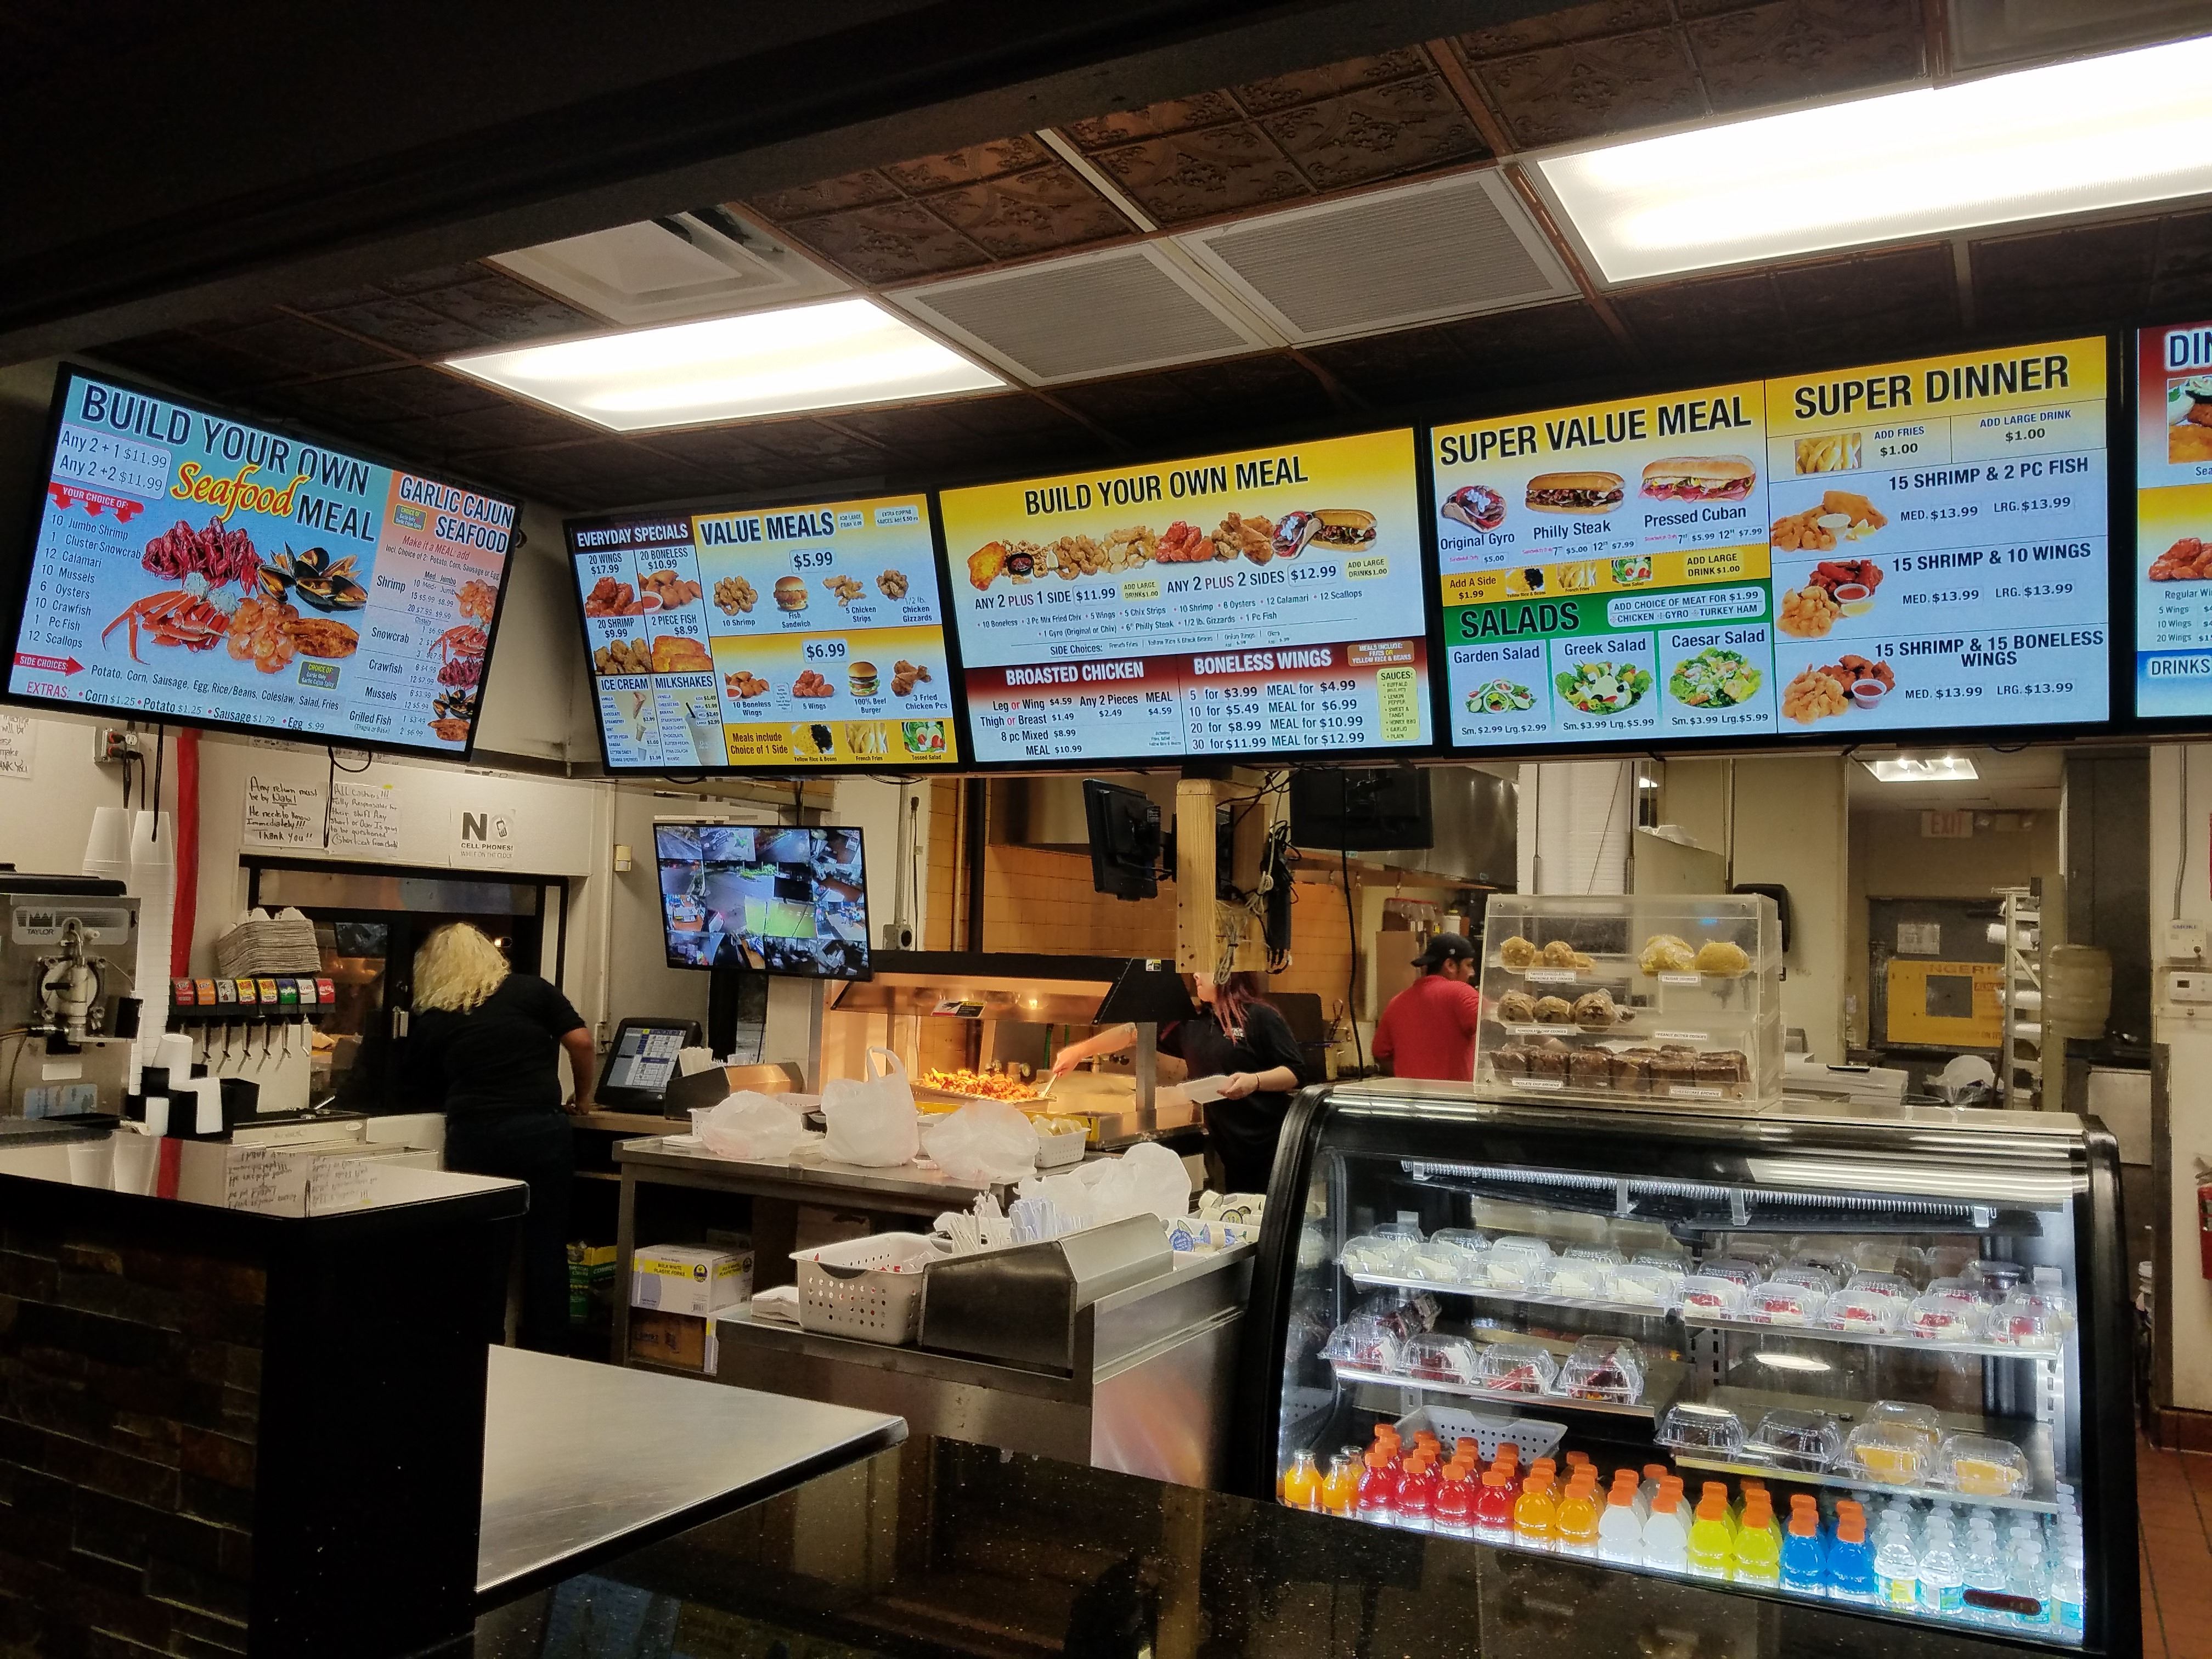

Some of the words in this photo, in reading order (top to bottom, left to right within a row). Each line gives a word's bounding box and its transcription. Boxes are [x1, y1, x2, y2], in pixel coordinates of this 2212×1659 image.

[1795, 374, 1912, 419] SUPER
[1926, 355, 2068, 403] DINNER
[1980, 417, 2001, 428] ADD
[2004, 413, 2037, 425] LARGE
[2040, 409, 2071, 422] DRINK
[81, 385, 191, 445] BUILD
[204, 418, 290, 474] YOUR
[298, 449, 370, 495] OWN
[1441, 425, 1537, 466] SUPER
[1546, 409, 1646, 451] VALUE
[1658, 396, 1751, 437] MEAL
[2005, 428, 2046, 443] $1.00
[62, 431, 86, 452] Any
[89, 438, 98, 453] 2
[115, 444, 119, 458] 1
[123, 449, 167, 467] $11.99
[1025, 484, 1091, 515] BUILD
[1098, 475, 1162, 506] YOUR
[1170, 465, 1227, 498] OWN
[1236, 455, 1308, 490] MEAL
[63, 487, 85, 499] YOUR
[86, 492, 115, 506] CHOICE
[116, 500, 128, 509] OF:
[171, 462, 311, 523] Seafood
[297, 494, 375, 542] MEAL
[400, 477, 461, 513] GARLIC
[464, 496, 514, 528] CAJUN
[1645, 510, 1698, 528] Pressed
[1702, 507, 1746, 521] Cuban
[52, 515, 63, 526] 10
[69, 518, 95, 533] Jumbo
[98, 525, 128, 541] Shrimp
[436, 516, 507, 553] SEAFOOD
[577, 531, 631, 547] EVERYDAY
[634, 523, 688, 542] SPECIALS
[701, 519, 761, 545] VALUE
[766, 512, 834, 541] MEALS
[1534, 526, 1568, 540] Philly
[1573, 520, 1611, 535] Steak
[45, 549, 56, 558] 12
[63, 551, 102, 568] Calamari
[589, 555, 597, 564] 20
[599, 553, 622, 563] WINGS
[640, 551, 648, 560] 20
[651, 548, 688, 558] BONELESS
[794, 552, 832, 570] $5.99
[1893, 557, 1912, 572] 15
[1917, 552, 1983, 570] SHRIMP
[1989, 550, 2002, 565] &
[2007, 549, 2028, 562] 10
[2032, 543, 2091, 562] WINGS
[42, 565, 53, 575] 10
[59, 567, 95, 583] Mussels
[591, 565, 619, 575] $17.99
[648, 560, 677, 571] $10.99
[377, 575, 405, 594] Shrimp
[1167, 580, 1189, 593] ANY
[1193, 577, 1201, 590] 2
[1206, 575, 1234, 590] PLUS
[1238, 572, 1246, 586] 2
[1250, 571, 1284, 586] SIDES
[1291, 566, 1336, 582] $12.99
[41, 581, 46, 591] 6
[56, 584, 90, 599] Oysters
[975, 598, 994, 610] ANY
[998, 595, 1005, 607] 2
[1008, 595, 1034, 606] PLUS
[1037, 592, 1042, 604] 1
[1047, 591, 1070, 603] SIDE
[1076, 588, 1115, 603] $11.99
[1902, 594, 1930, 605] MED.
[1932, 590, 1979, 605] $13.99
[36, 597, 46, 608] 10
[53, 600, 91, 616] Crawfish
[1614, 602, 1631, 611] ADD
[1635, 600, 1666, 609] CHOICE
[1683, 597, 1706, 606] MEAT
[1709, 595, 1726, 603] FOR
[1729, 591, 1758, 602] $1.99
[853, 615, 871, 623] Strips
[1461, 602, 1579, 638] SALADS
[29, 631, 39, 641] 12
[46, 634, 82, 648] Scallops
[372, 627, 409, 644] Snowcrab
[1672, 635, 1720, 648] Caesar
[1725, 629, 1765, 644] Salad
[2013, 630, 2104, 650] BONELESS
[806, 644, 845, 661] $6.99
[1454, 650, 1499, 663] Garden
[1503, 646, 1539, 660] Salad
[20, 656, 36, 665] SIDE
[37, 659, 68, 670] CHOICES:
[369, 659, 403, 674] Crawfish
[1194, 654, 1274, 675] BONELESS
[1277, 650, 1331, 669] WINGS
[2152, 659, 2211, 675] DRINKS
[656, 676, 712, 688] MILKSHAKES
[1006, 669, 1078, 685] BROASTED
[1082, 662, 1144, 680] CHICKEN
[1381, 672, 1413, 680] SAUCES:
[27, 681, 69, 698] EXTRAS:
[92, 665, 122, 679] Potato,
[127, 670, 148, 684] Corn,
[153, 674, 189, 690] Sausage,
[194, 680, 210, 693] Egg,
[212, 682, 257, 699] Rice/Beans,
[262, 690, 295, 705] Coleslaw,
[299, 696, 320, 708] Salad,
[322, 699, 338, 710] Fries
[601, 679, 616, 690] ICE
[618, 678, 648, 690] CREAM
[365, 687, 397, 701] Mussels
[349, 711, 374, 724] Grilled
[375, 715, 391, 726] Fish
[861, 707, 881, 715] Burger
[980, 716, 1005, 727] Thigh
[1007, 717, 1015, 725] or
[1018, 714, 1047, 725] Breast
[732, 732, 754, 742] Meals
[757, 731, 782, 742] include
[1001, 732, 1007, 741] 8
[1009, 733, 1019, 743] pc
[1022, 730, 1048, 740] Mixed
[1054, 730, 1076, 738] $8.99
[1193, 739, 1204, 750] 30
[1210, 738, 1223, 749] for
[1226, 738, 1266, 749] $11.99
[1272, 735, 1300, 746] MEAL
[1304, 734, 1317, 745] for
[1321, 733, 1364, 744] $12.99
[1931, 812, 1962, 834] EXIT
